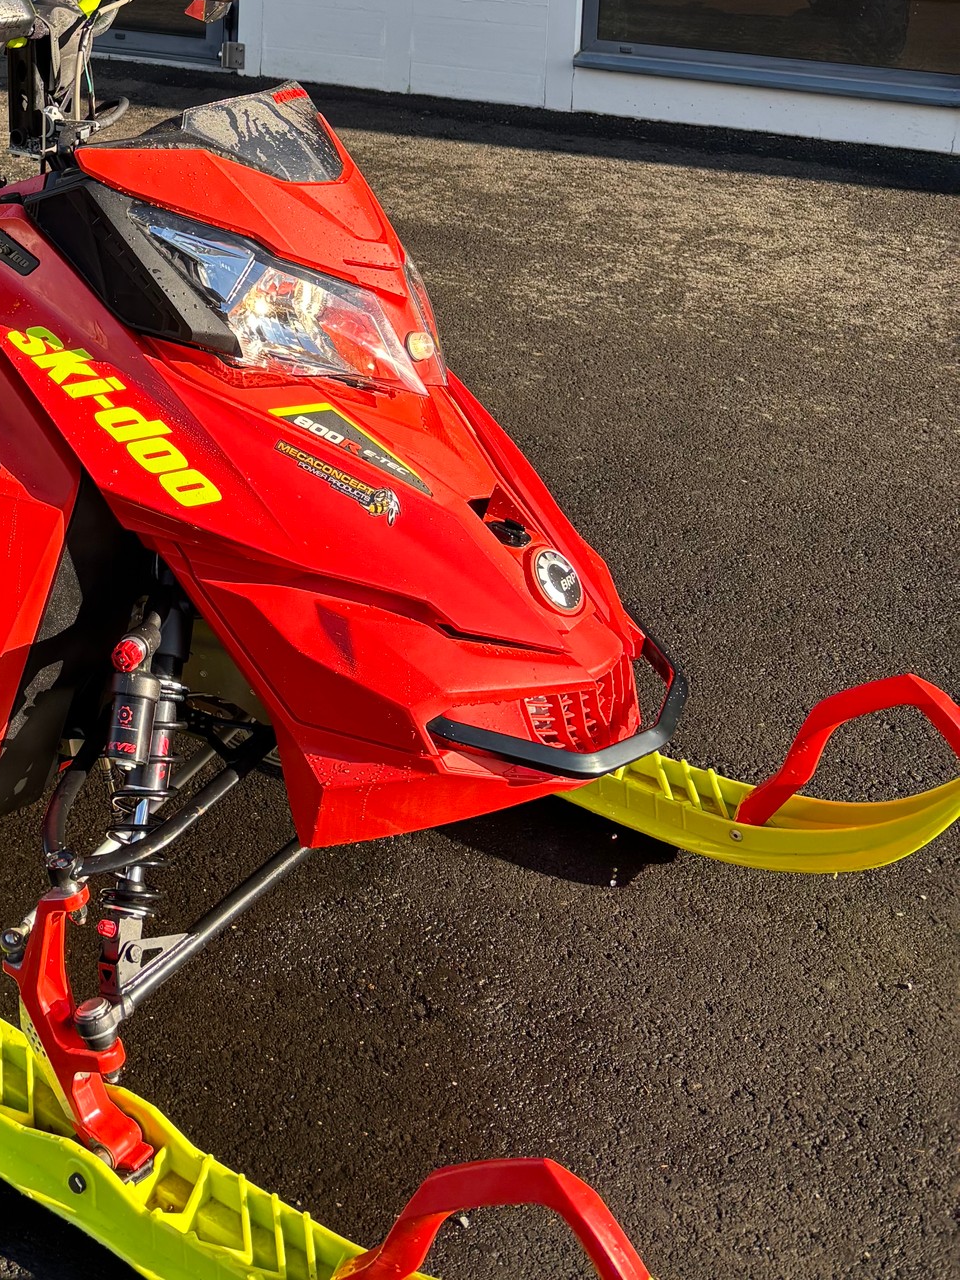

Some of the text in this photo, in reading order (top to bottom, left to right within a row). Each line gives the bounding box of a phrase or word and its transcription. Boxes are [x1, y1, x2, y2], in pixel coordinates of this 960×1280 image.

[7, 326, 222, 507] ski-doo
[277, 441, 375, 495] MECACONCEPT
[298, 461, 328, 480] POWER
[327, 476, 371, 502] PRODUCTS
[561, 572, 576, 591] BRP
